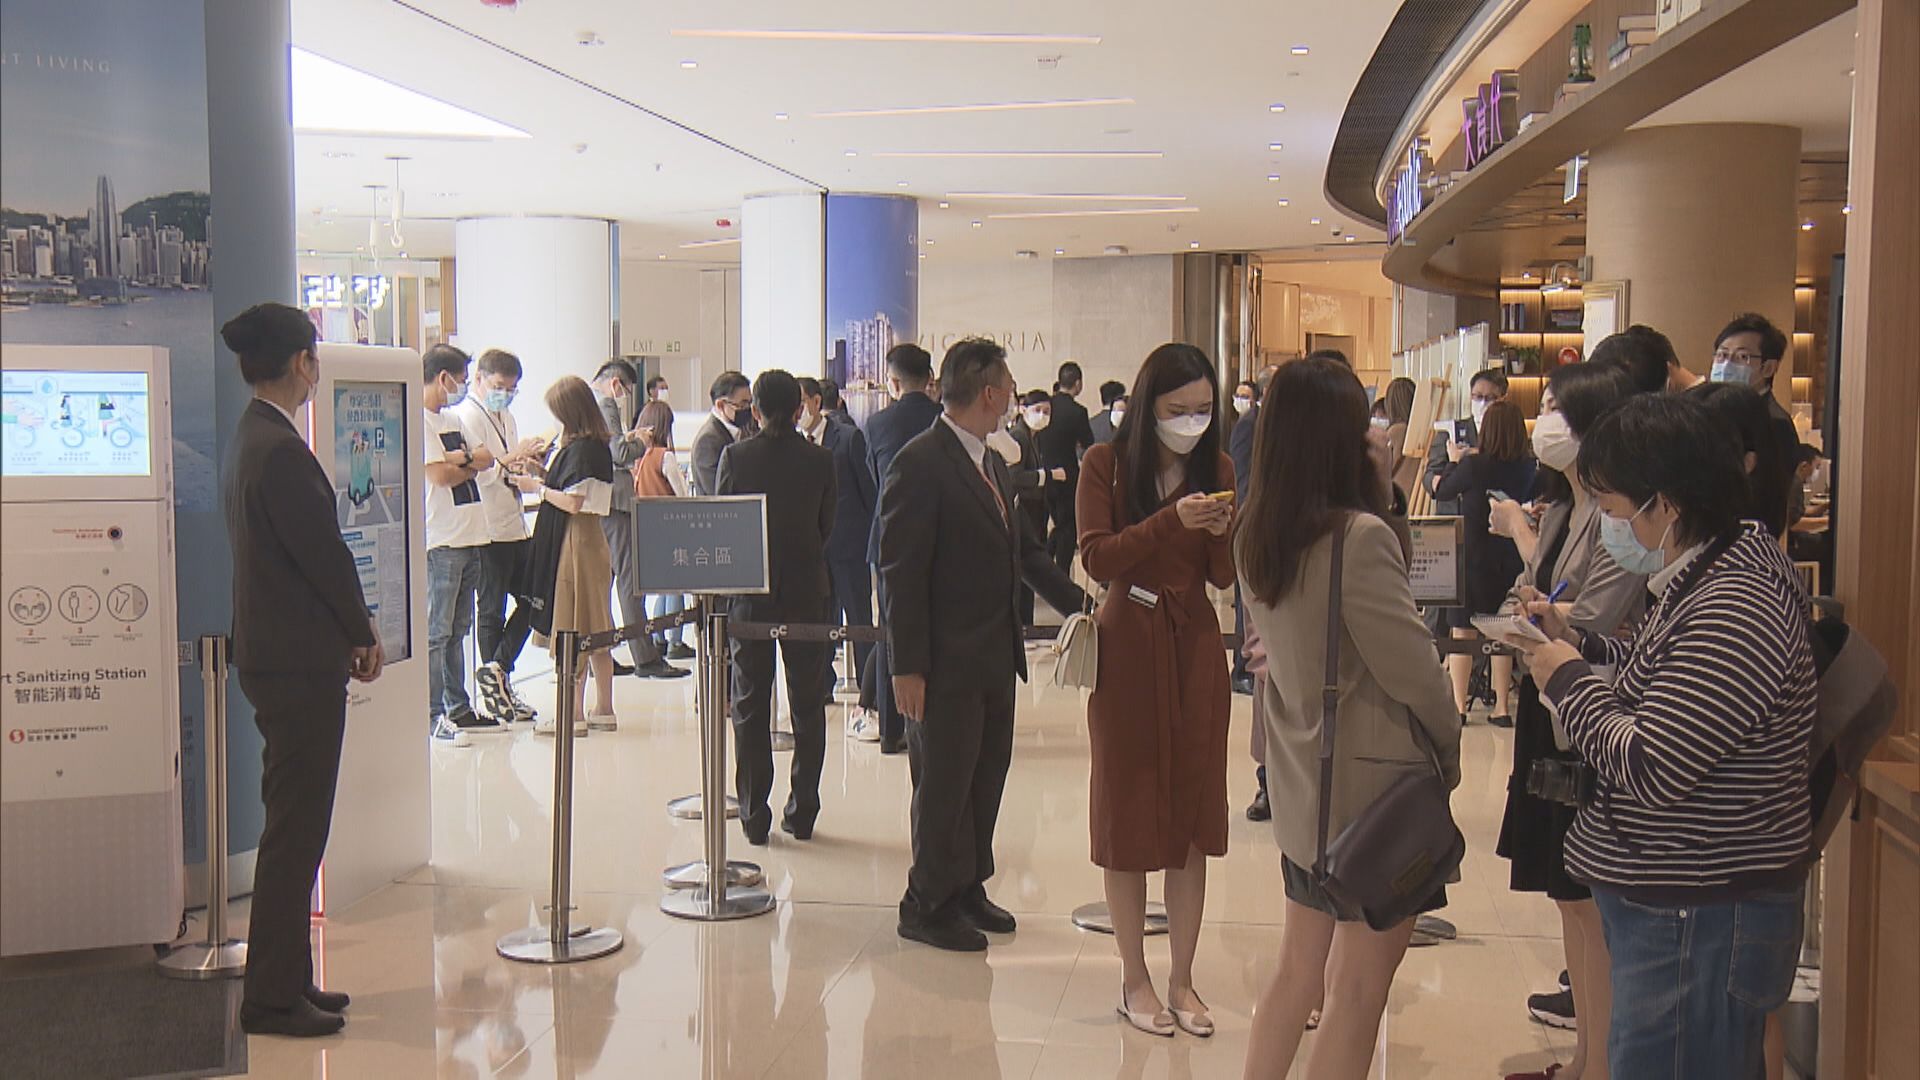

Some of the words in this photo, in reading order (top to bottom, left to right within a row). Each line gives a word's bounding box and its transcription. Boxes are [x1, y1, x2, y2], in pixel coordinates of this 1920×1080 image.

[37, 55, 110, 73] LIVING
[632, 339, 655, 353] EXIT
[673, 546, 732, 567] 集合區
[16, 669, 91, 684] Sanitizing
[95, 667, 147, 680] Station
[14, 685, 101, 704] 智能消毒站
